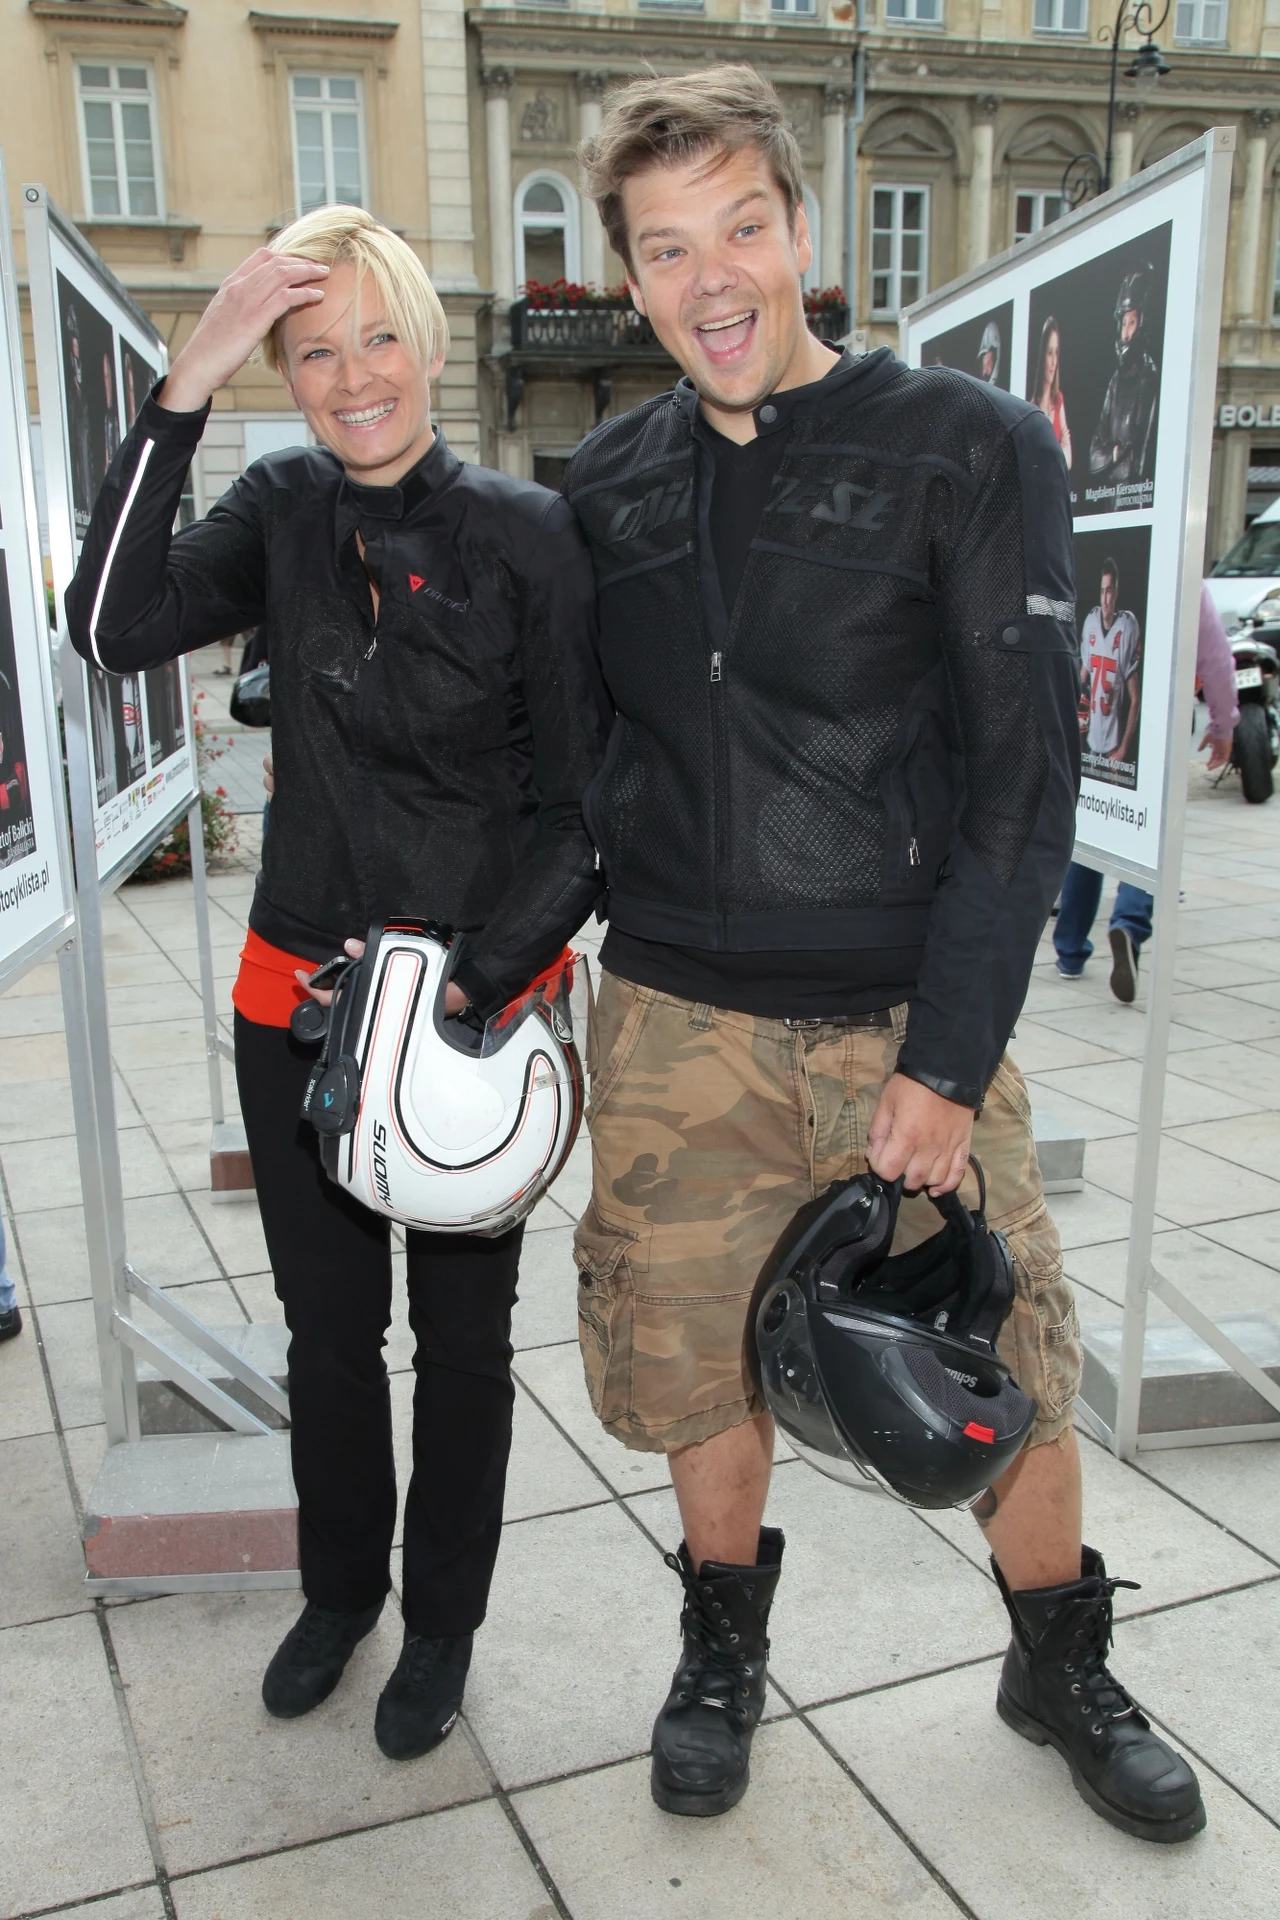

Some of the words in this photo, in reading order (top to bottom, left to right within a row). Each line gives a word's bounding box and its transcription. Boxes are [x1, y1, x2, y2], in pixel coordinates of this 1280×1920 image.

[1090, 654, 1117, 716] 75
[373, 1119, 394, 1209] SUOMY
[944, 1367, 978, 1387] Schu
